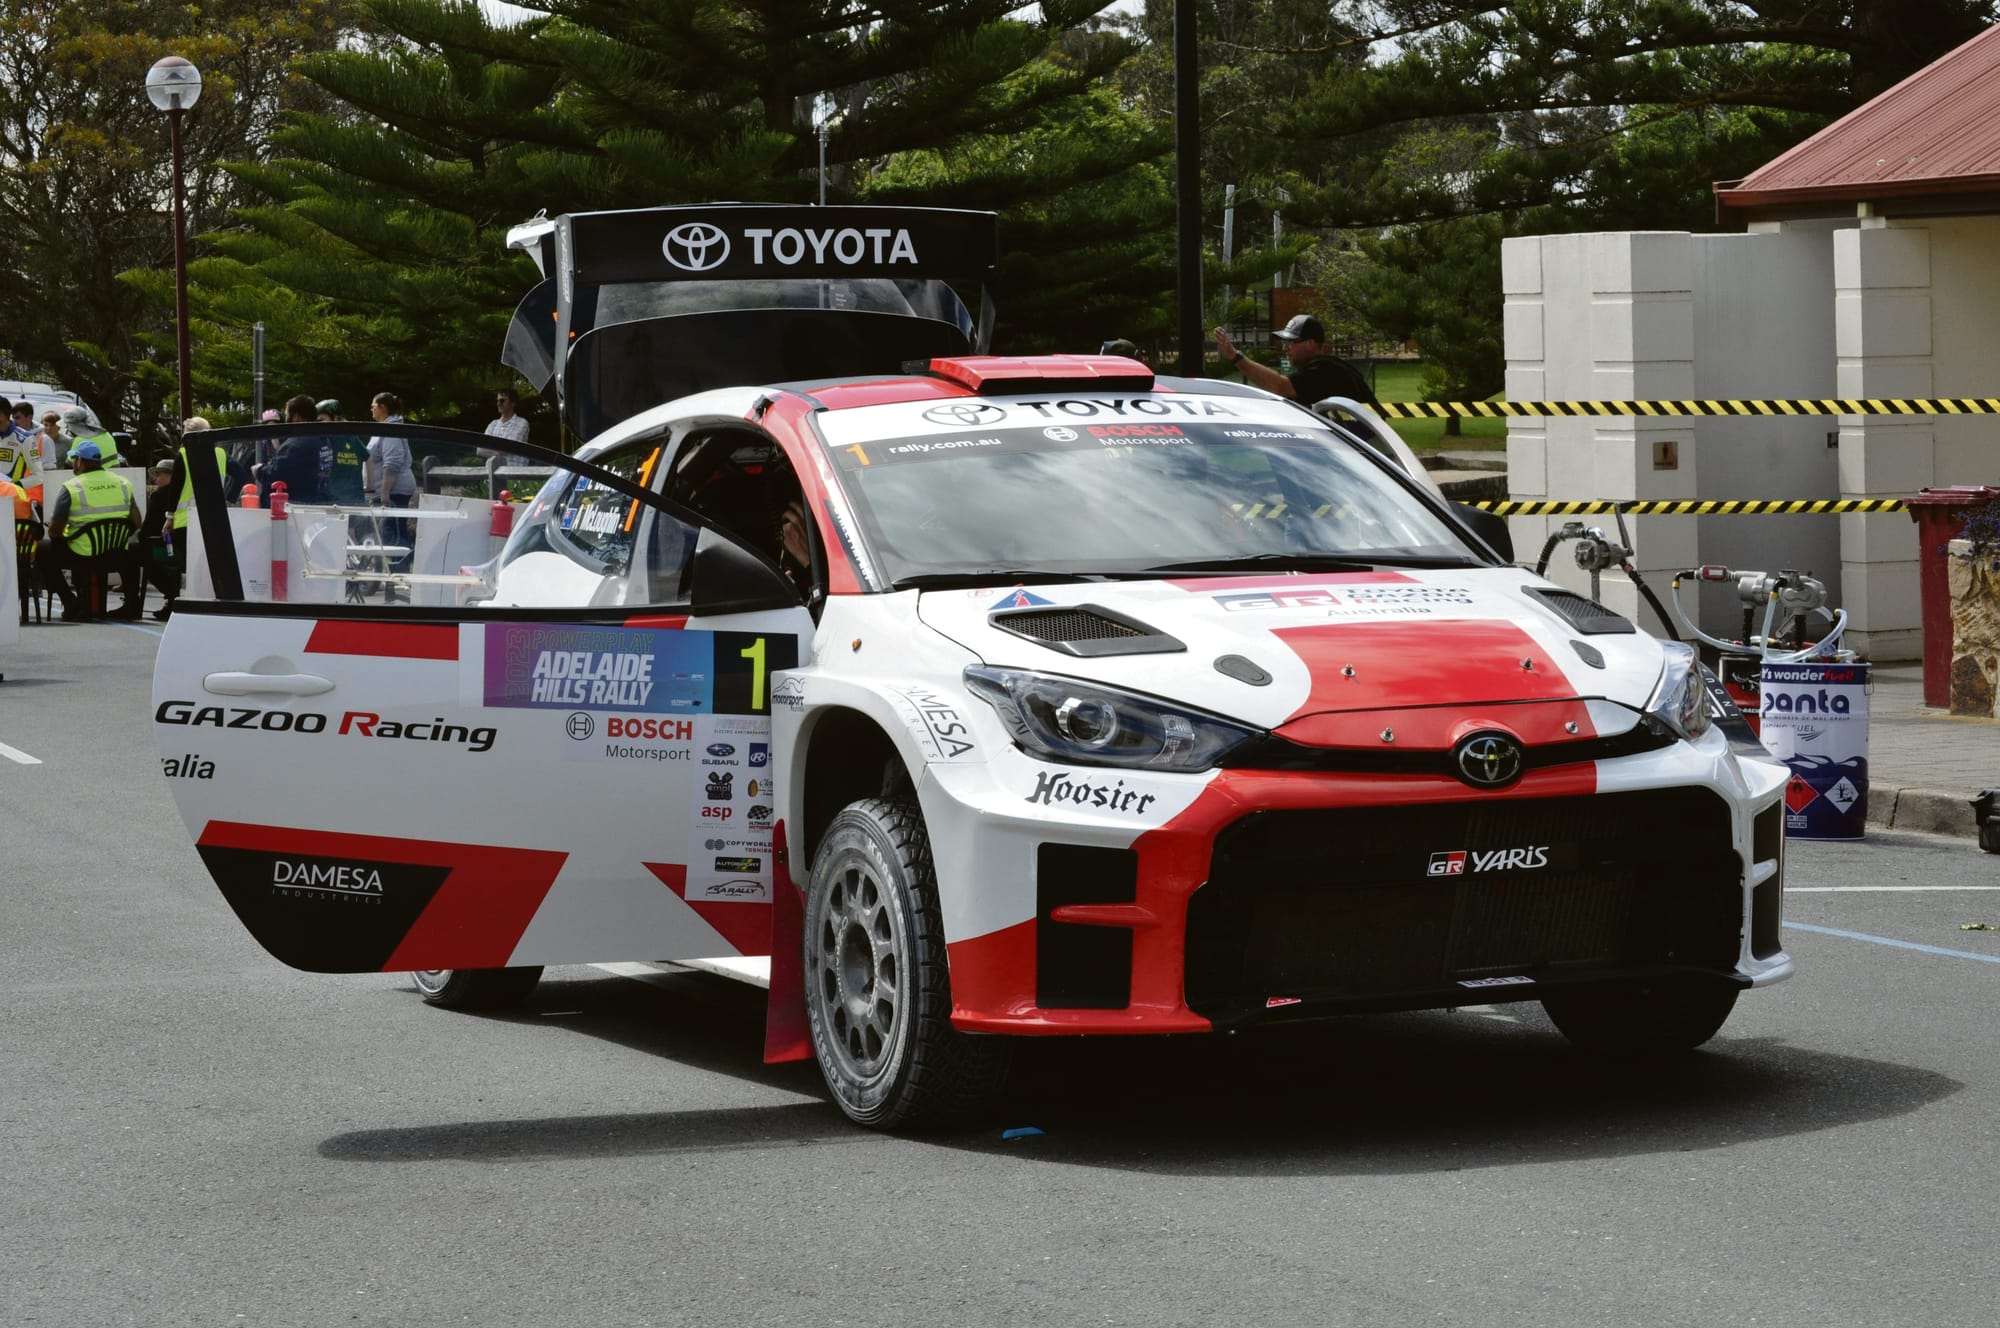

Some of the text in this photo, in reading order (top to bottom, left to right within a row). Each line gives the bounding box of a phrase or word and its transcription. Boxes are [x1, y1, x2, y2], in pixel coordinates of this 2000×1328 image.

[744, 228, 918, 264] TOYOTA
[1016, 399, 1238, 418] TOYOTA
[1087, 425, 1184, 437] BOSCH
[1224, 429, 1313, 440] rally.com.au
[889, 437, 1001, 454] rally.com.au
[1099, 436, 1193, 447] Motorsport
[846, 443, 871, 466] 1
[89, 484, 117, 492] CHAPLAIN
[1328, 605, 1431, 617] Australia
[531, 629, 656, 654] POWERPLAY
[532, 650, 655, 683] ADELAIDE
[740, 637, 766, 710] 1
[531, 678, 654, 706] HILLS RALLY
[155, 700, 498, 753] GAZOO Racing
[607, 717, 693, 741] BOSCH
[605, 744, 690, 761] Motorsport
[701, 758, 739, 766] SUBARU
[1024, 770, 1156, 815] Hoosier
[701, 806, 732, 820] asp
[273, 860, 383, 892] DAMESA
[272, 888, 382, 904] INDUSTRIES
